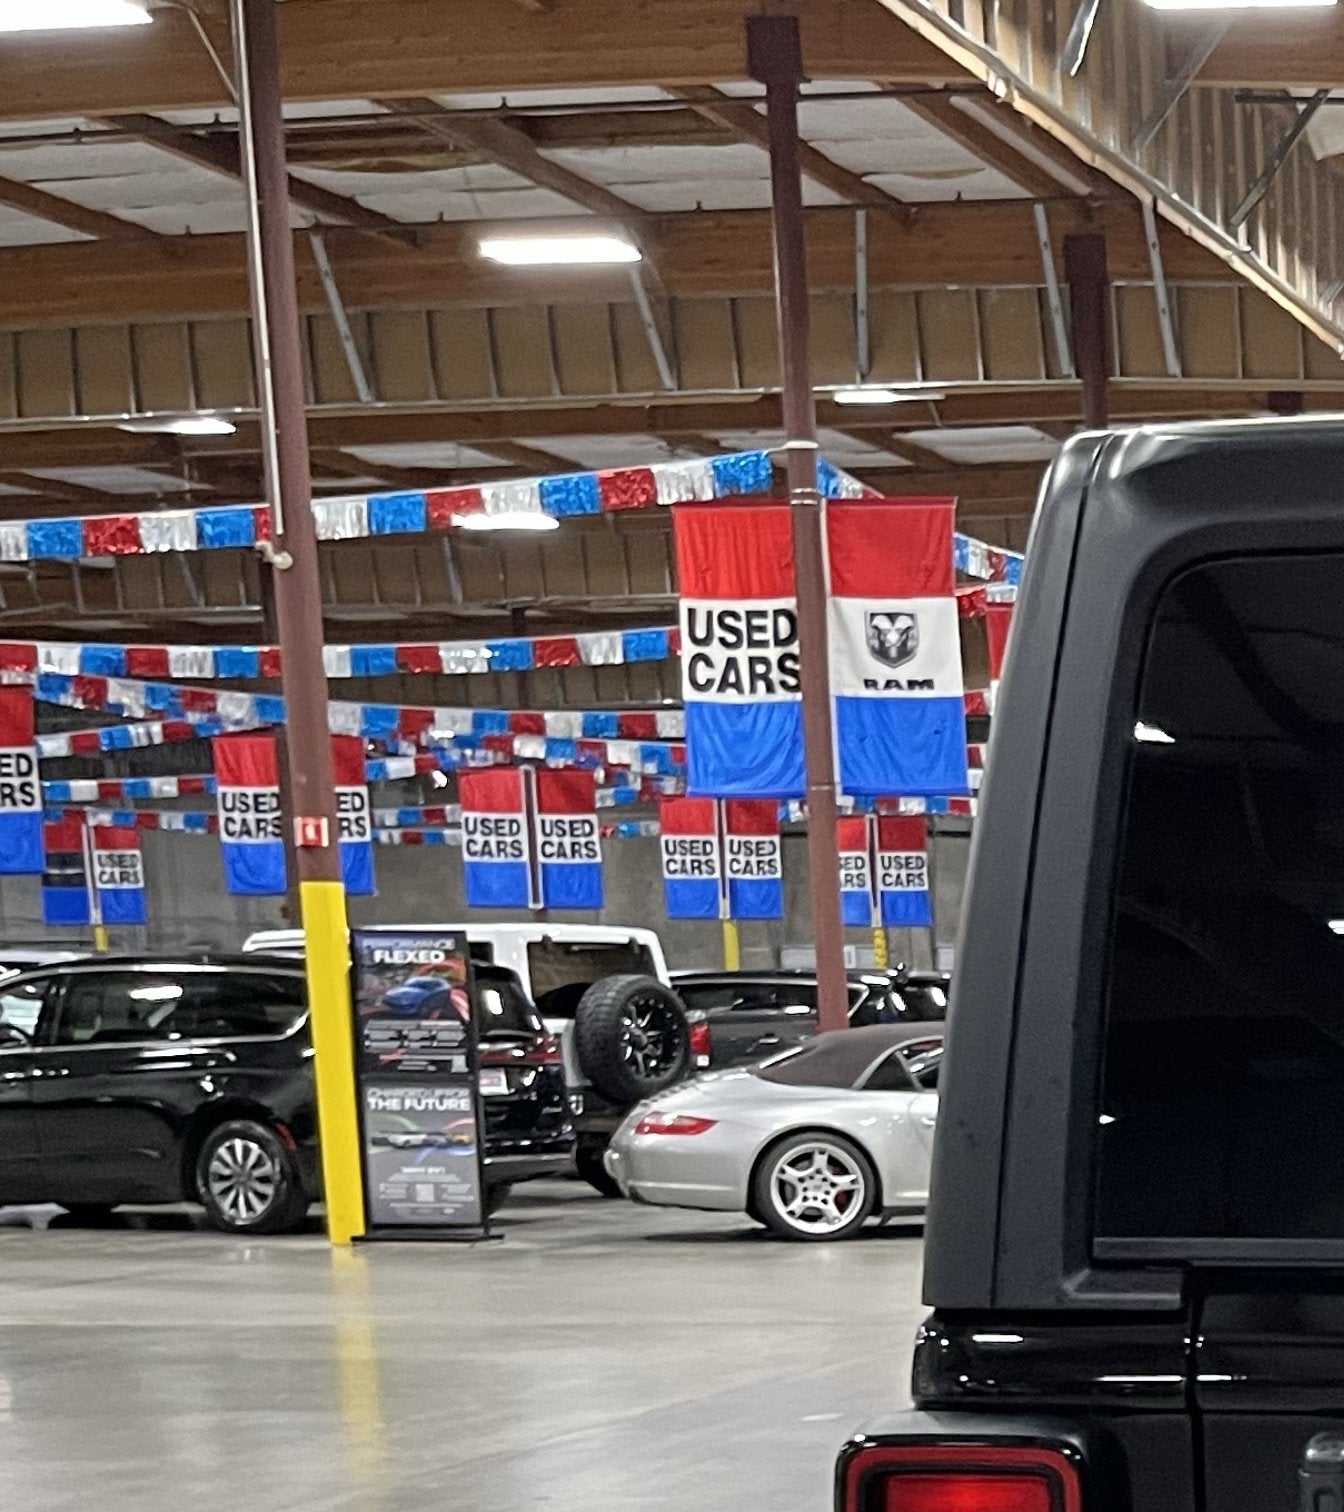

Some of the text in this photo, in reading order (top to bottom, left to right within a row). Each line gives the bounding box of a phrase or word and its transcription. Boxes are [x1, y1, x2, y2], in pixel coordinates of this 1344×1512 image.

[687, 607, 798, 649] USED
[687, 652, 800, 694] CARS
[863, 678, 936, 691] RAM
[0, 753, 32, 777] ED
[0, 782, 35, 807] RS
[222, 792, 279, 814] USED
[336, 792, 364, 812] ED
[224, 816, 282, 839] CARS
[338, 816, 367, 838] RS
[464, 817, 521, 837] USED
[541, 819, 595, 838] USED
[466, 839, 524, 858] CARS
[541, 840, 598, 860] CARS
[664, 839, 714, 857] USED
[728, 838, 777, 857] USED
[99, 853, 139, 868] USED
[665, 858, 716, 876] CARS
[728, 858, 778, 876] CARS
[839, 855, 866, 871] ED
[881, 855, 925, 871] USED
[98, 870, 139, 885] CARS
[843, 872, 867, 888] RS
[881, 872, 926, 888] CARS
[373, 949, 446, 964] FLEXED
[368, 1098, 470, 1111] THE FUTURE
